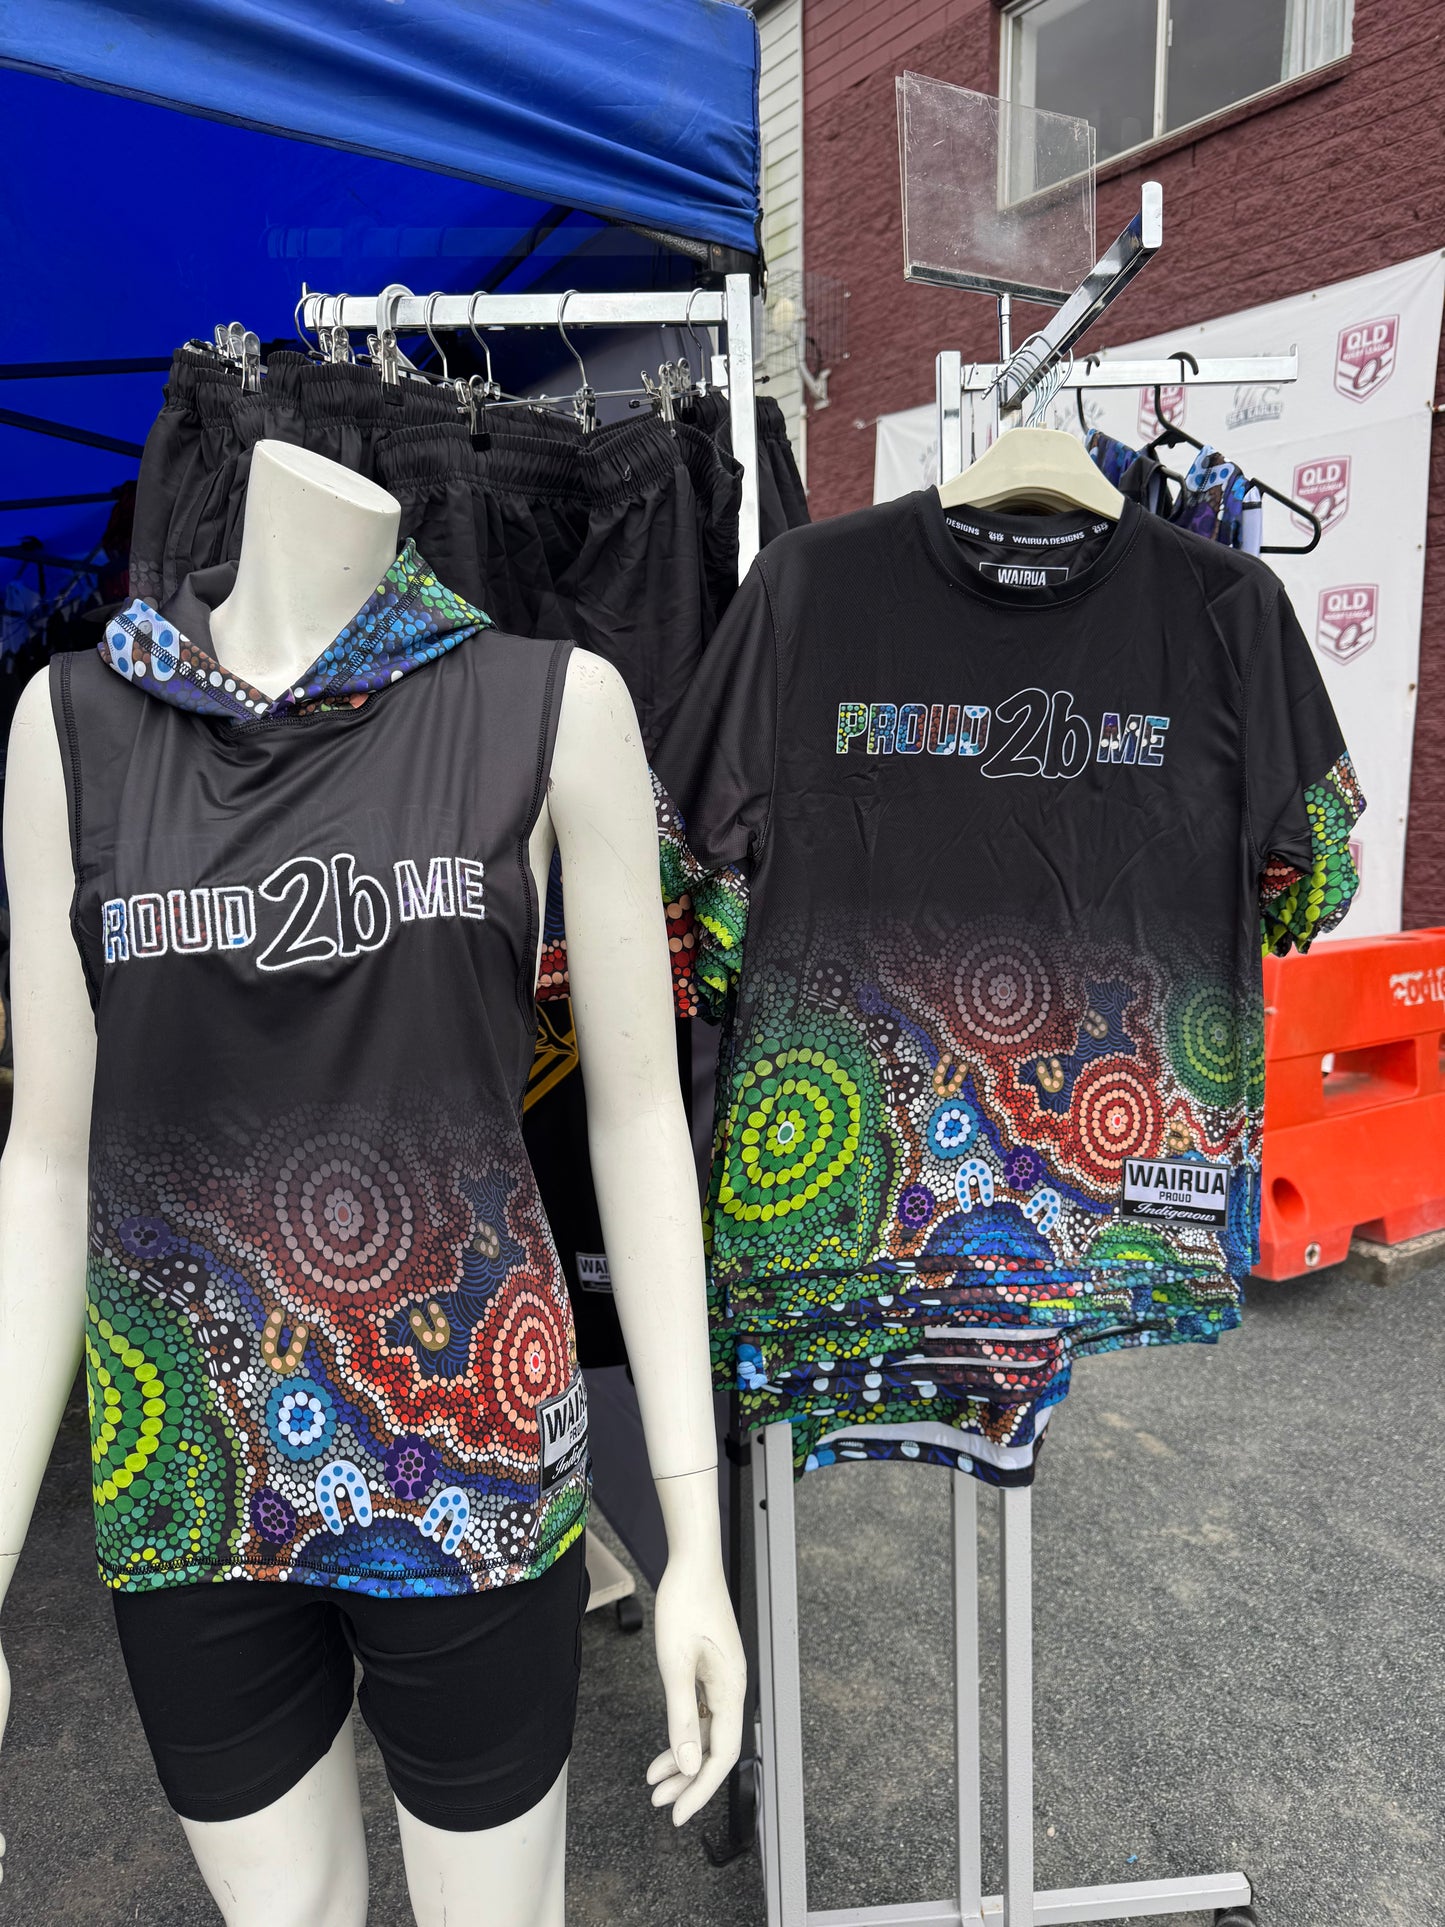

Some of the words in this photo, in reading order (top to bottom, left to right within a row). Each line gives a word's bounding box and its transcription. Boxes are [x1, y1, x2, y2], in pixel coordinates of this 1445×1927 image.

[1347, 325, 1388, 351] QLD
[1302, 464, 1341, 487] QLD
[945, 517, 980, 536] DESIGNS
[1012, 535, 1049, 546] WAIRUA
[1050, 531, 1085, 545] DESIGNS
[998, 568, 1046, 586] WAIRUA
[1327, 592, 1368, 612] QLD
[836, 702, 992, 756] PROUD
[980, 687, 1092, 779] 2b
[1096, 712, 1170, 766] ME
[102, 885, 258, 964] ROUD
[255, 853, 391, 971] 2b
[393, 856, 486, 923] ME
[1128, 1164, 1225, 1195] WAIRUA
[1159, 1191, 1192, 1203] PROUD
[1133, 1203, 1216, 1221] Indigenous
